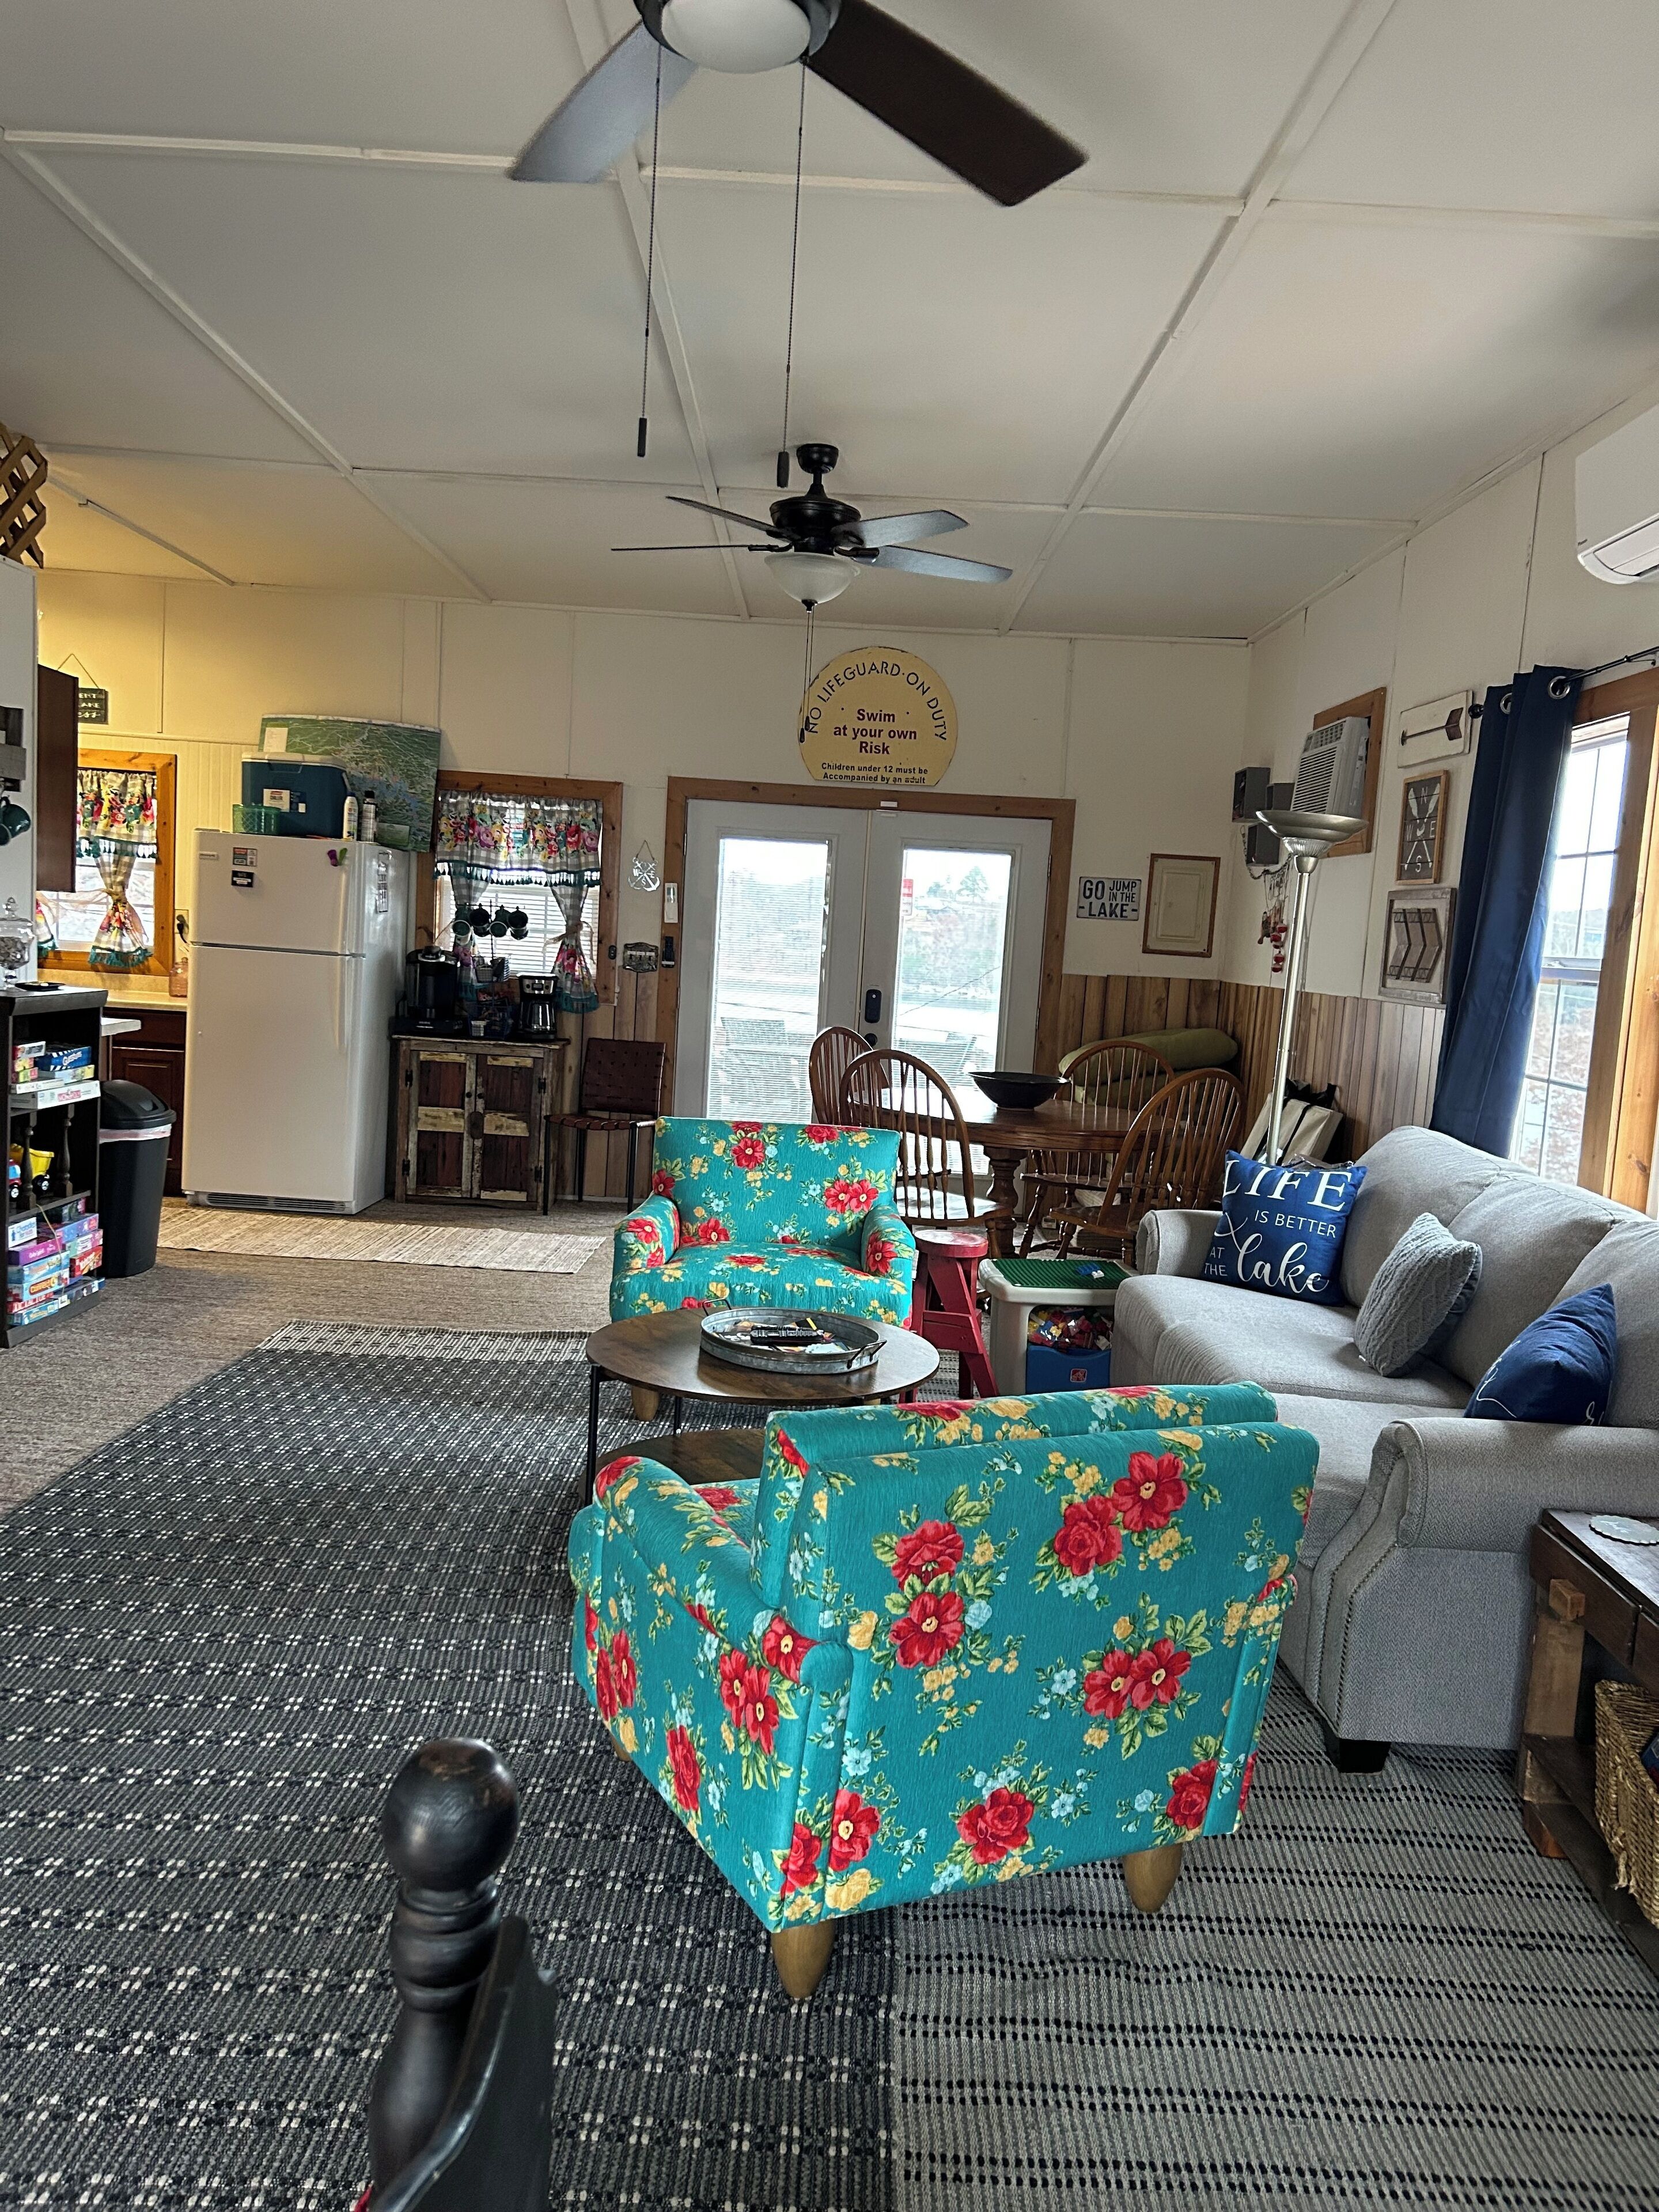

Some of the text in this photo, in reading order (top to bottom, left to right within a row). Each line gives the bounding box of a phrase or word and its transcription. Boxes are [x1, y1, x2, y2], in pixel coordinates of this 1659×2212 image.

[808, 661, 947, 741] NO LIFEGUARD ON DUTY
[857, 708, 895, 723] Swim
[834, 725, 917, 740] at your own
[859, 741, 890, 755] Risk
[821, 762, 855, 771] Children
[884, 765, 893, 773] 12
[823, 772, 878, 782] Accompanied
[881, 775, 891, 784] by
[1421, 786, 1428, 805] N
[1429, 820, 1436, 838] E
[1415, 855, 1422, 873] S
[1083, 880, 1137, 900] GO JUMP
[1109, 892, 1136, 903] IN THE
[1088, 902, 1129, 918] LAKE
[1222, 1160, 1352, 1211] LIFE
[1255, 1210, 1336, 1238] IS BETTER
[1210, 1247, 1225, 1259] AT
[1204, 1263, 1228, 1277] THE
